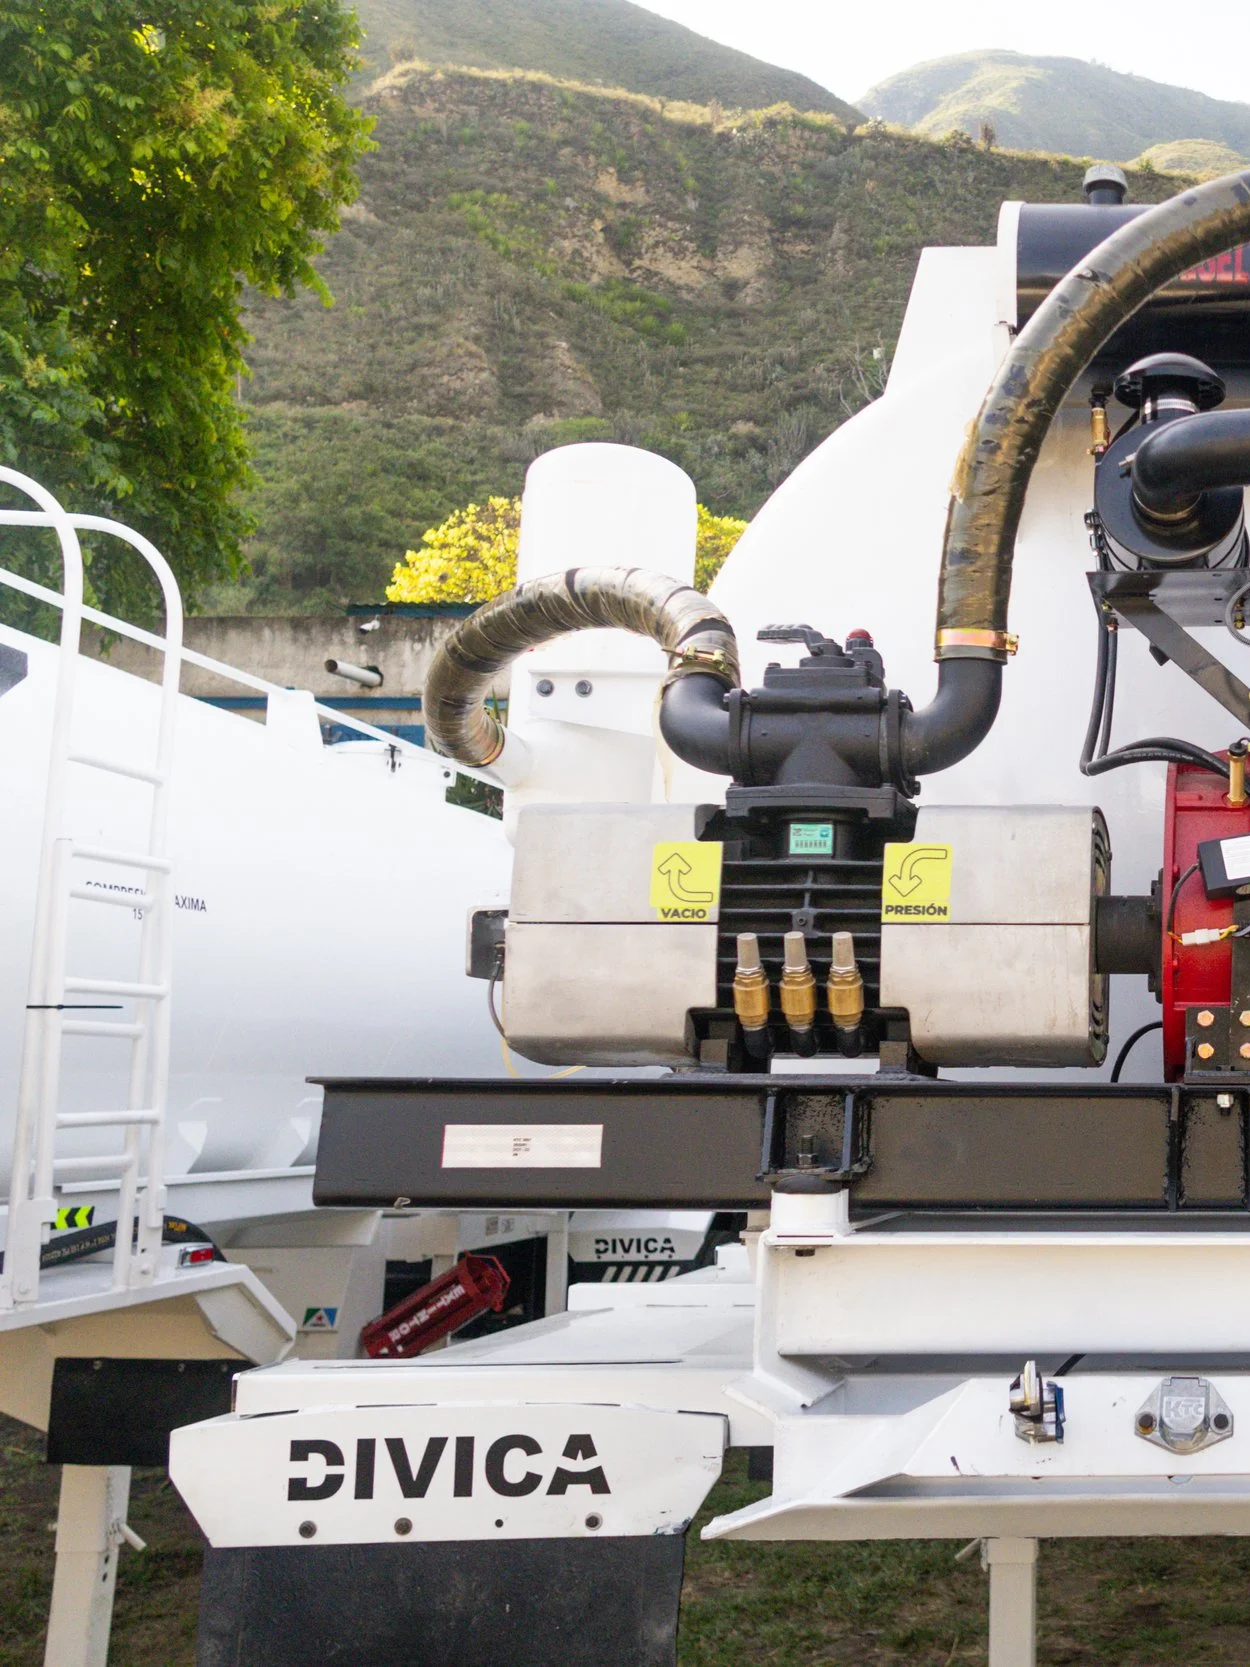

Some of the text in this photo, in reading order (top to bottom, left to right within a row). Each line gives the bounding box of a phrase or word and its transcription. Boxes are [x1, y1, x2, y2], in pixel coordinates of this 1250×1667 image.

[660, 908, 707, 919] VACIO
[884, 903, 947, 917] PRESIÓN
[594, 1237, 675, 1255] DIVICA
[387, 1283, 467, 1342] EXTINTOR
[1165, 1399, 1203, 1418] KTC
[287, 1433, 612, 1501] DIVICA
